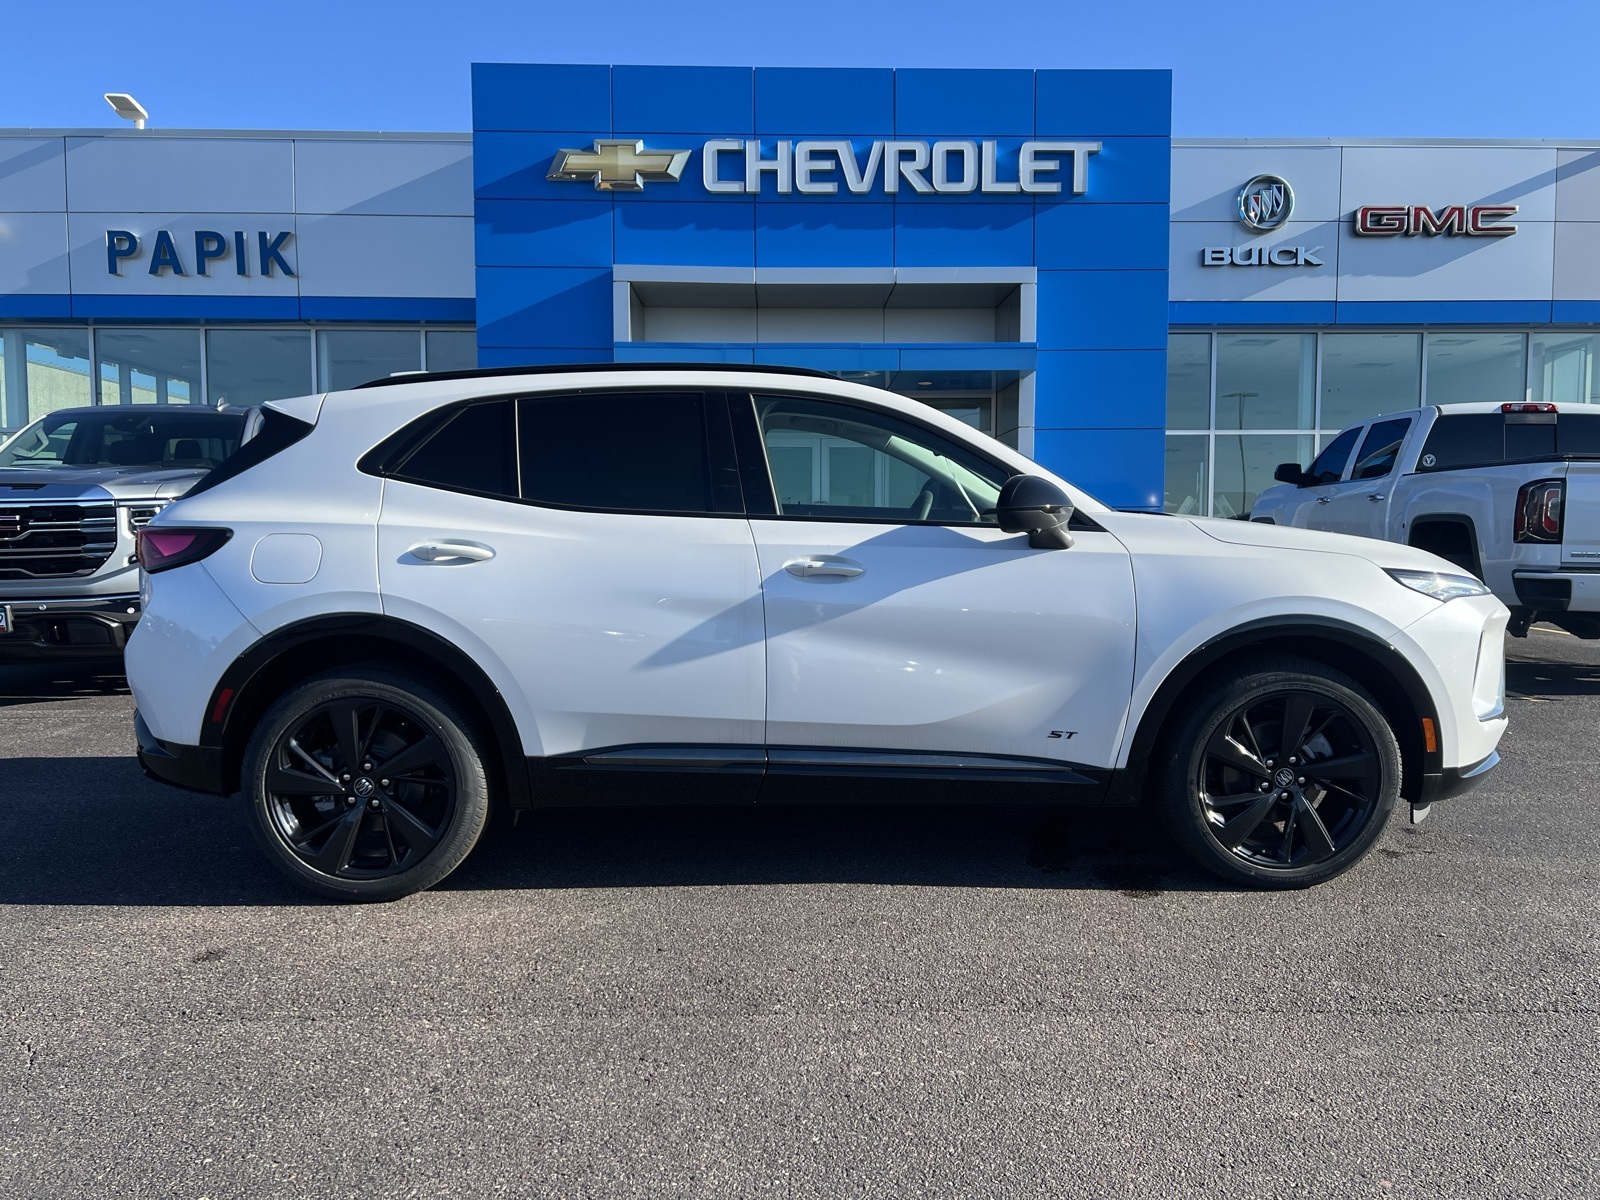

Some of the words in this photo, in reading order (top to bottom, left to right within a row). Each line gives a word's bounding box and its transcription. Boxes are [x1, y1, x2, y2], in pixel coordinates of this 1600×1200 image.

[702, 139, 1102, 194] CHEVROLET
[1356, 204, 1519, 236] GMC
[106, 230, 297, 277] PAPIK
[1203, 246, 1325, 267] BUICK
[1047, 730, 1079, 739] ST
